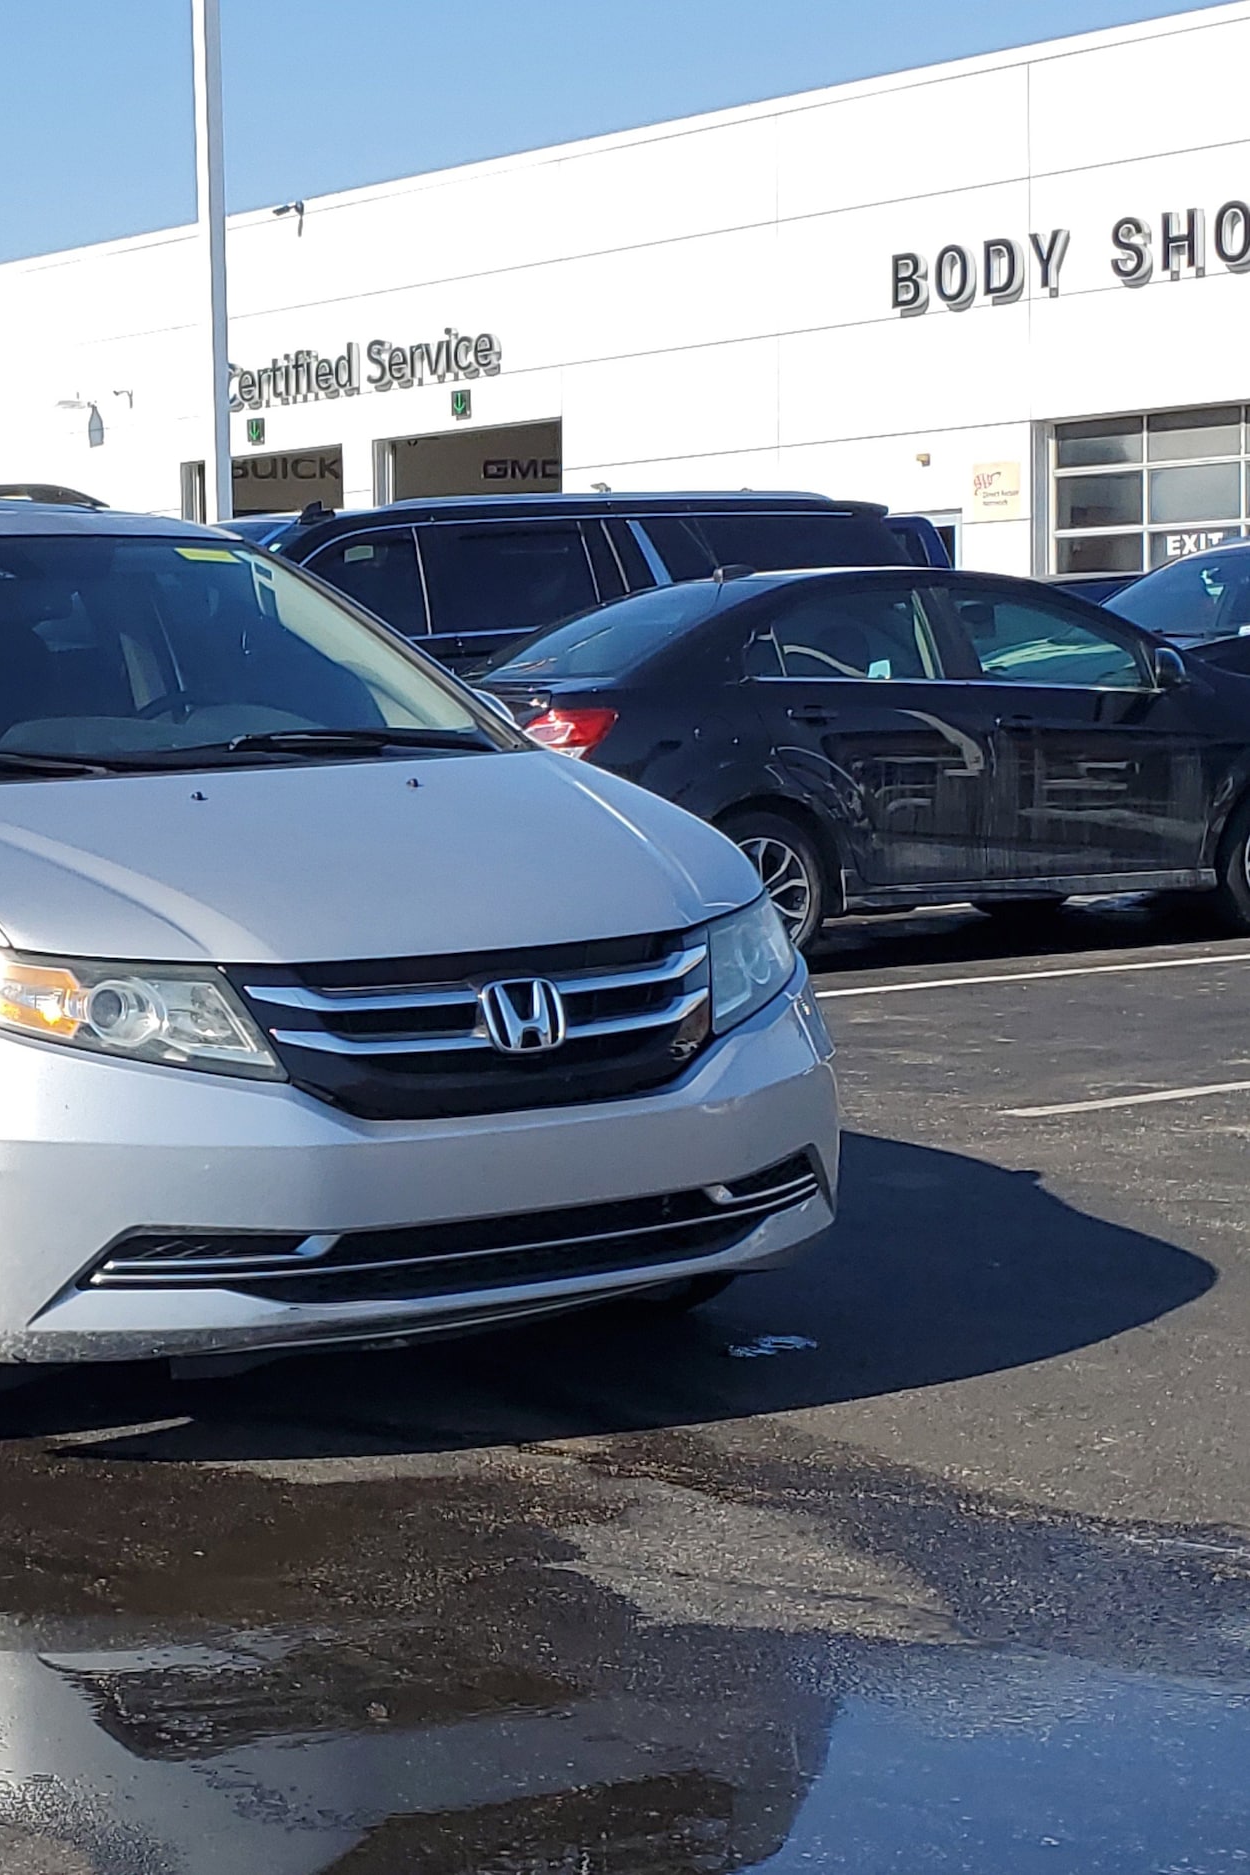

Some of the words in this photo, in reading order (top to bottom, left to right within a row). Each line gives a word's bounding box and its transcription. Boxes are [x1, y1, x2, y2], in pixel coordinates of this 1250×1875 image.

[891, 229, 1070, 318] BODY
[1111, 200, 1250, 288] SHO
[366, 328, 502, 391] Service
[1166, 532, 1224, 556] EXIT
